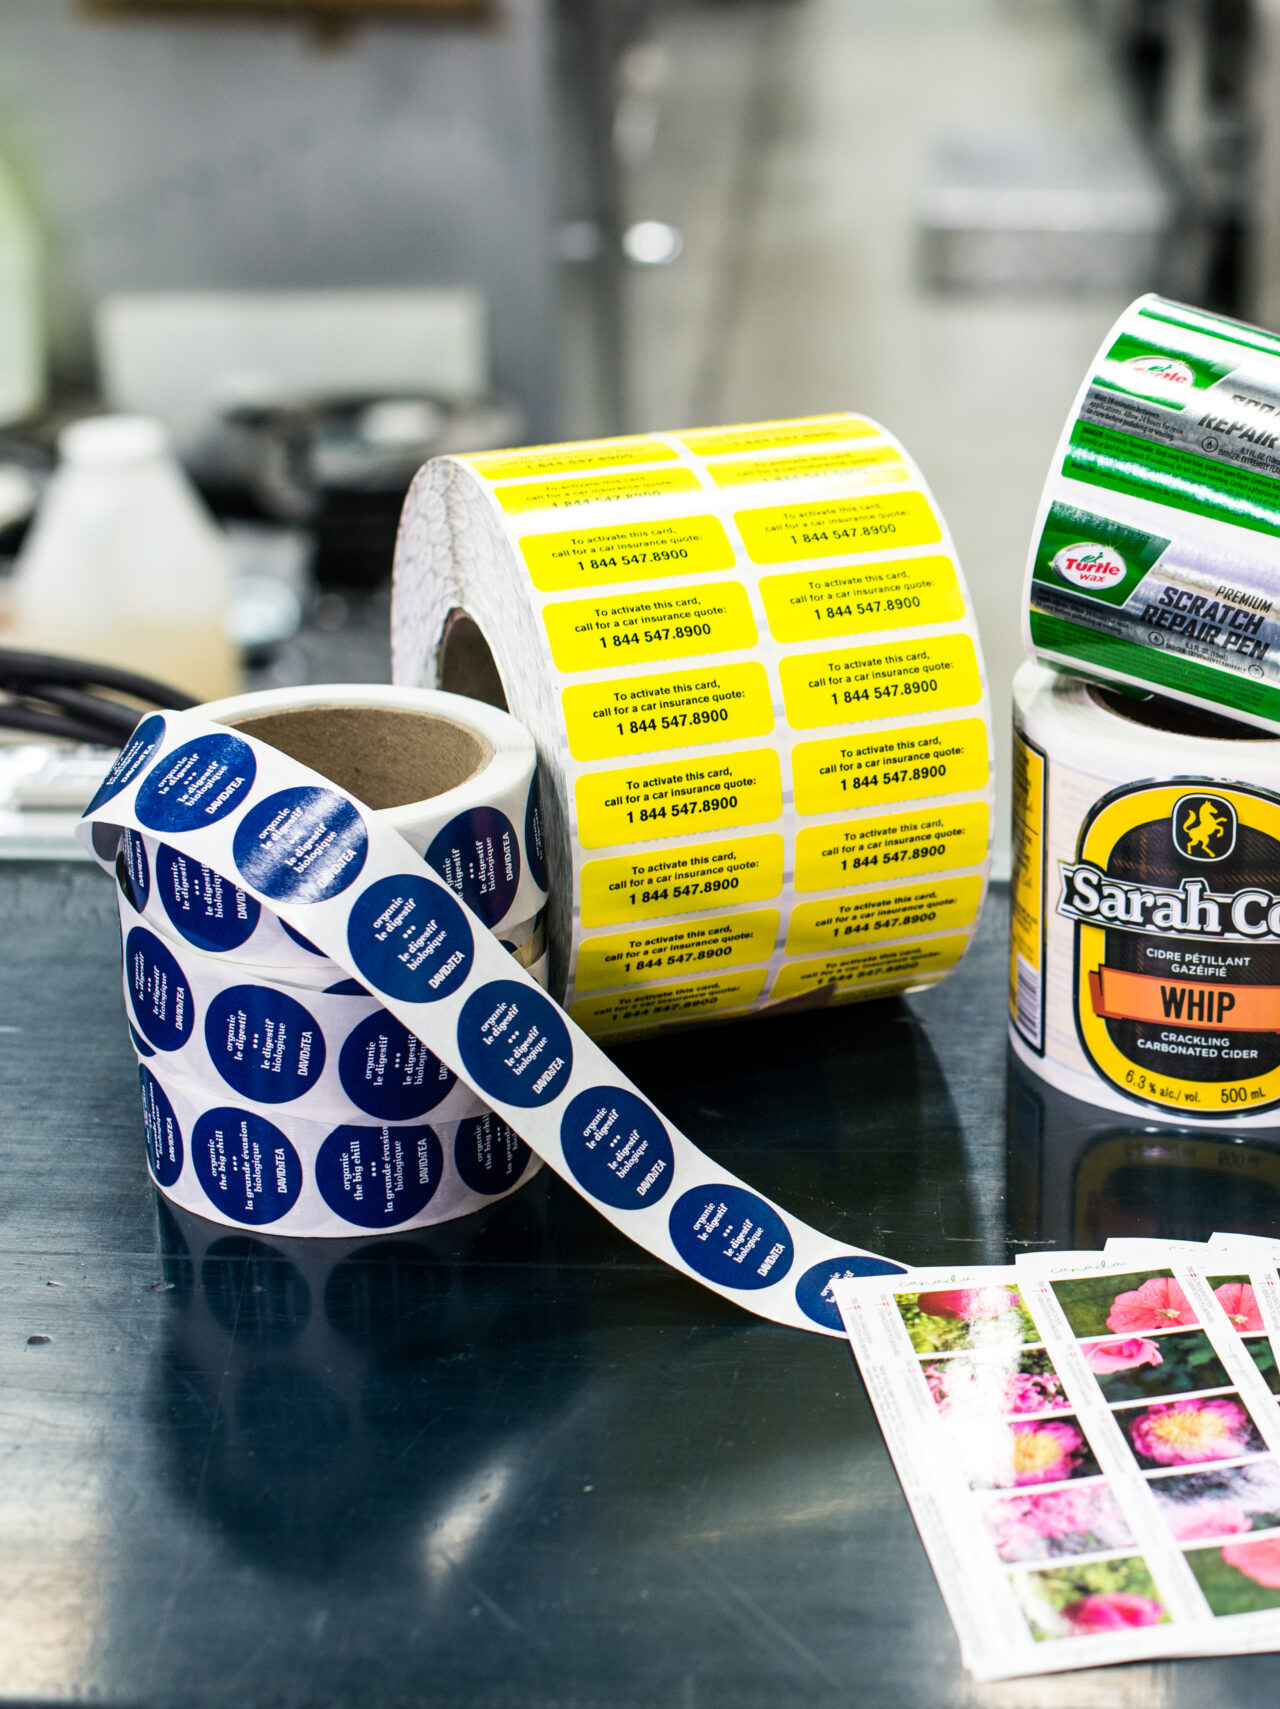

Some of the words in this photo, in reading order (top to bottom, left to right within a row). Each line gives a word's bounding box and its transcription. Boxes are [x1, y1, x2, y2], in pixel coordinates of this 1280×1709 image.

[1064, 557, 1121, 577] Turtle
[1079, 571, 1106, 583] wax
[1158, 585, 1265, 635] SCRATCH
[1216, 585, 1274, 614] PREMIUM
[1139, 603, 1223, 647] REPAIR
[1223, 631, 1271, 661] PEN
[808, 677, 825, 687] call
[828, 676, 842, 684] for
[854, 673, 868, 681] car
[871, 666, 919, 678] insurance
[922, 660, 953, 673] quote:
[827, 663, 841, 671] To
[844, 658, 882, 669] activate
[884, 655, 903, 663] this
[905, 650, 929, 661] card,
[592, 707, 611, 718] call
[613, 706, 628, 715] for
[640, 702, 656, 711] car
[659, 695, 709, 708] insurance
[711, 690, 744, 702] quote:
[613, 692, 627, 701] To
[630, 687, 670, 699] activate
[672, 683, 692, 693] this
[694, 679, 720, 690] card,
[831, 693, 837, 704] 1
[843, 688, 869, 703] 844
[873, 679, 937, 699] 547.8900
[616, 722, 623, 735] 1
[629, 718, 656, 733] 844
[661, 708, 728, 729] 547.8900
[1073, 868, 1222, 932] Sarah
[1146, 948, 1181, 962] CIDRE
[1185, 953, 1251, 967] PÉTILLANT
[1171, 963, 1227, 977] GAZÉIFIÉ
[480, 1002, 507, 1032] organic
[1160, 985, 1236, 1023] WHIP
[226, 1014, 235, 1051] organic
[234, 1010, 246, 1050] digestif
[261, 1018, 274, 1058] digestif
[482, 1035, 493, 1044] le
[491, 1003, 518, 1036] digestif
[271, 1022, 286, 1072] biologique
[297, 1031, 312, 1075] DAVIDsTEA
[503, 1057, 515, 1066] le
[512, 1025, 539, 1058] digestif
[1137, 1038, 1218, 1058] CARBONATED
[1221, 1049, 1259, 1059] CIDER
[1160, 1032, 1230, 1047] CRACKLING
[233, 1051, 242, 1060] le
[260, 1059, 270, 1069] le
[511, 1036, 547, 1075] biologique
[531, 1057, 564, 1094] DAVIDsTEA
[1125, 1069, 1147, 1089] 6.3
[1149, 1082, 1156, 1095] %
[1184, 1091, 1201, 1103] vol.
[1221, 1087, 1248, 1104] 500
[1251, 1087, 1266, 1100] mL
[214, 1130, 224, 1153] chill
[238, 1121, 249, 1159] évasion
[207, 1137, 217, 1176] organic
[217, 1155, 226, 1171] big
[251, 1142, 262, 1192] biologique
[274, 1148, 287, 1193] DAVIDsTEA
[219, 1173, 227, 1189] the
[241, 1160, 254, 1198] grande
[244, 1200, 253, 1210] la
